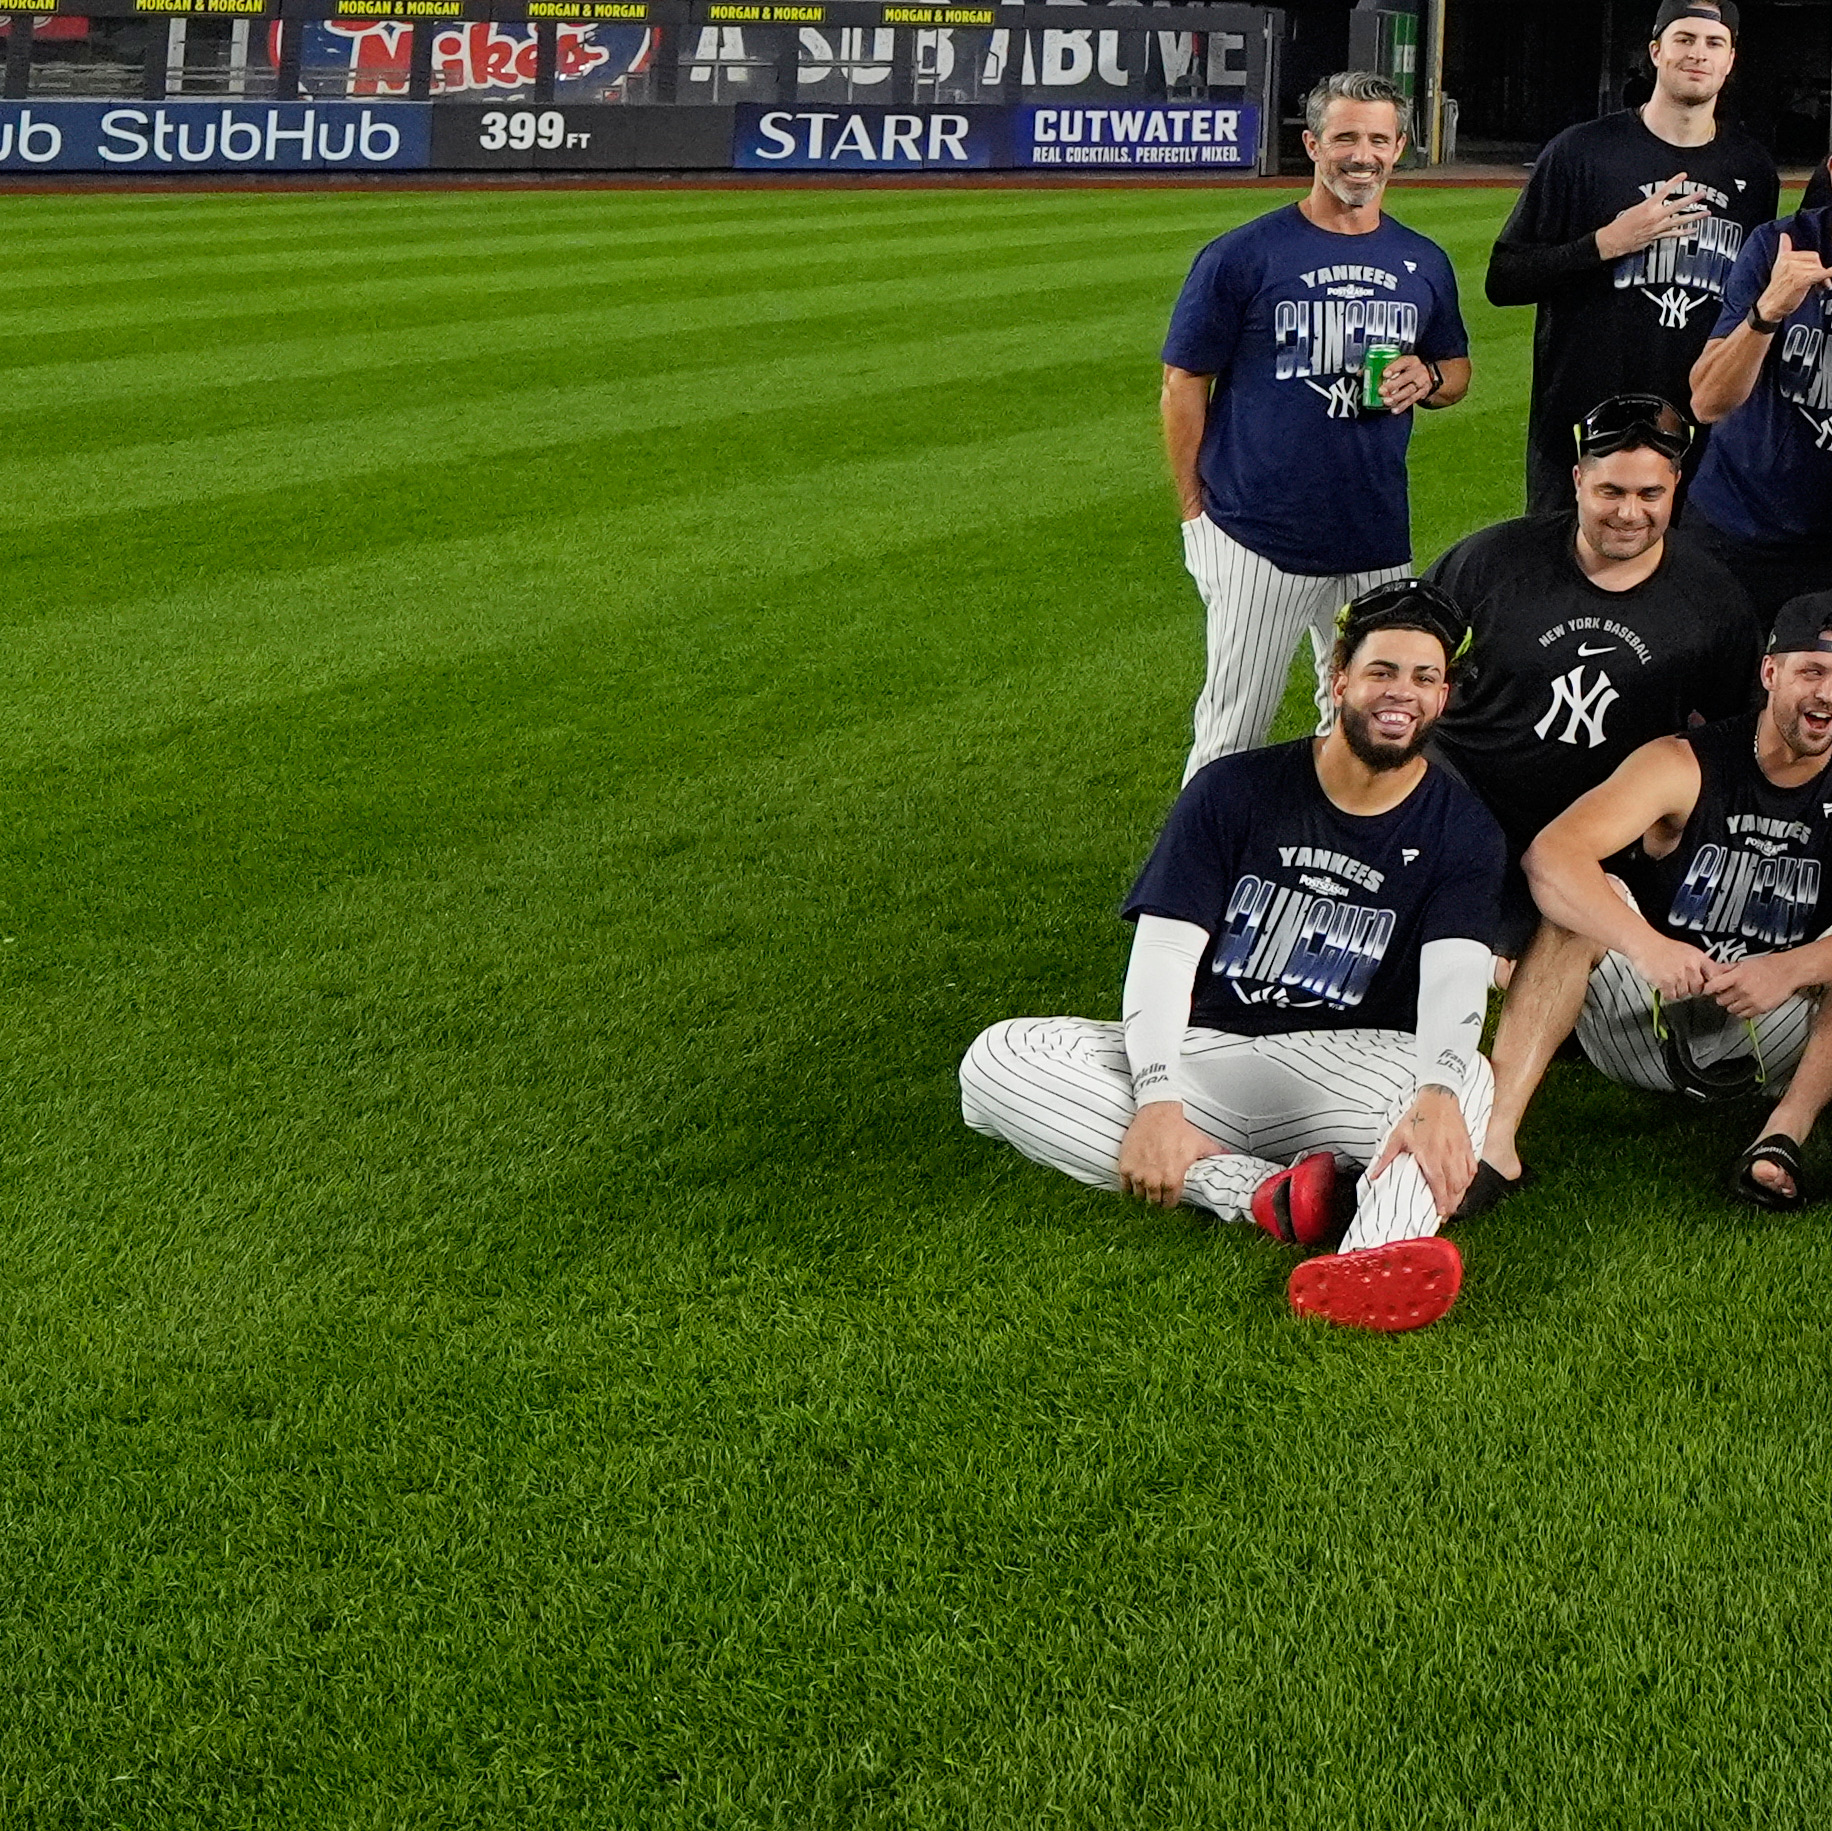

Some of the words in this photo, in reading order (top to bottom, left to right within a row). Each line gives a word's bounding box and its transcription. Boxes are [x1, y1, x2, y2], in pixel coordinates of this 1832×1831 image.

[528, 3, 581, 17] MORGAN
[582, 4, 593, 17] &
[595, 4, 646, 19] MORGAN
[884, 8, 932, 22] MORGAN
[934, 10, 944, 22] &
[945, 10, 993, 24] MORGAN
[97, 109, 401, 164] StubHub
[755, 111, 970, 162] STARR
[1033, 109, 1240, 144] CUTWATER
[1033, 146, 1063, 163] REAL
[1065, 146, 1132, 165] COCKTAILS.
[1136, 147, 1199, 165] PERFECTLY
[1201, 147, 1241, 164] MIXED.
[1537, 619, 1568, 649] NEW
[1566, 615, 1603, 632] YORK
[1602, 617, 1653, 665] BASEBALL
[1276, 844, 1386, 895] YANKEES
[1210, 872, 1398, 1008] CLINCHED
